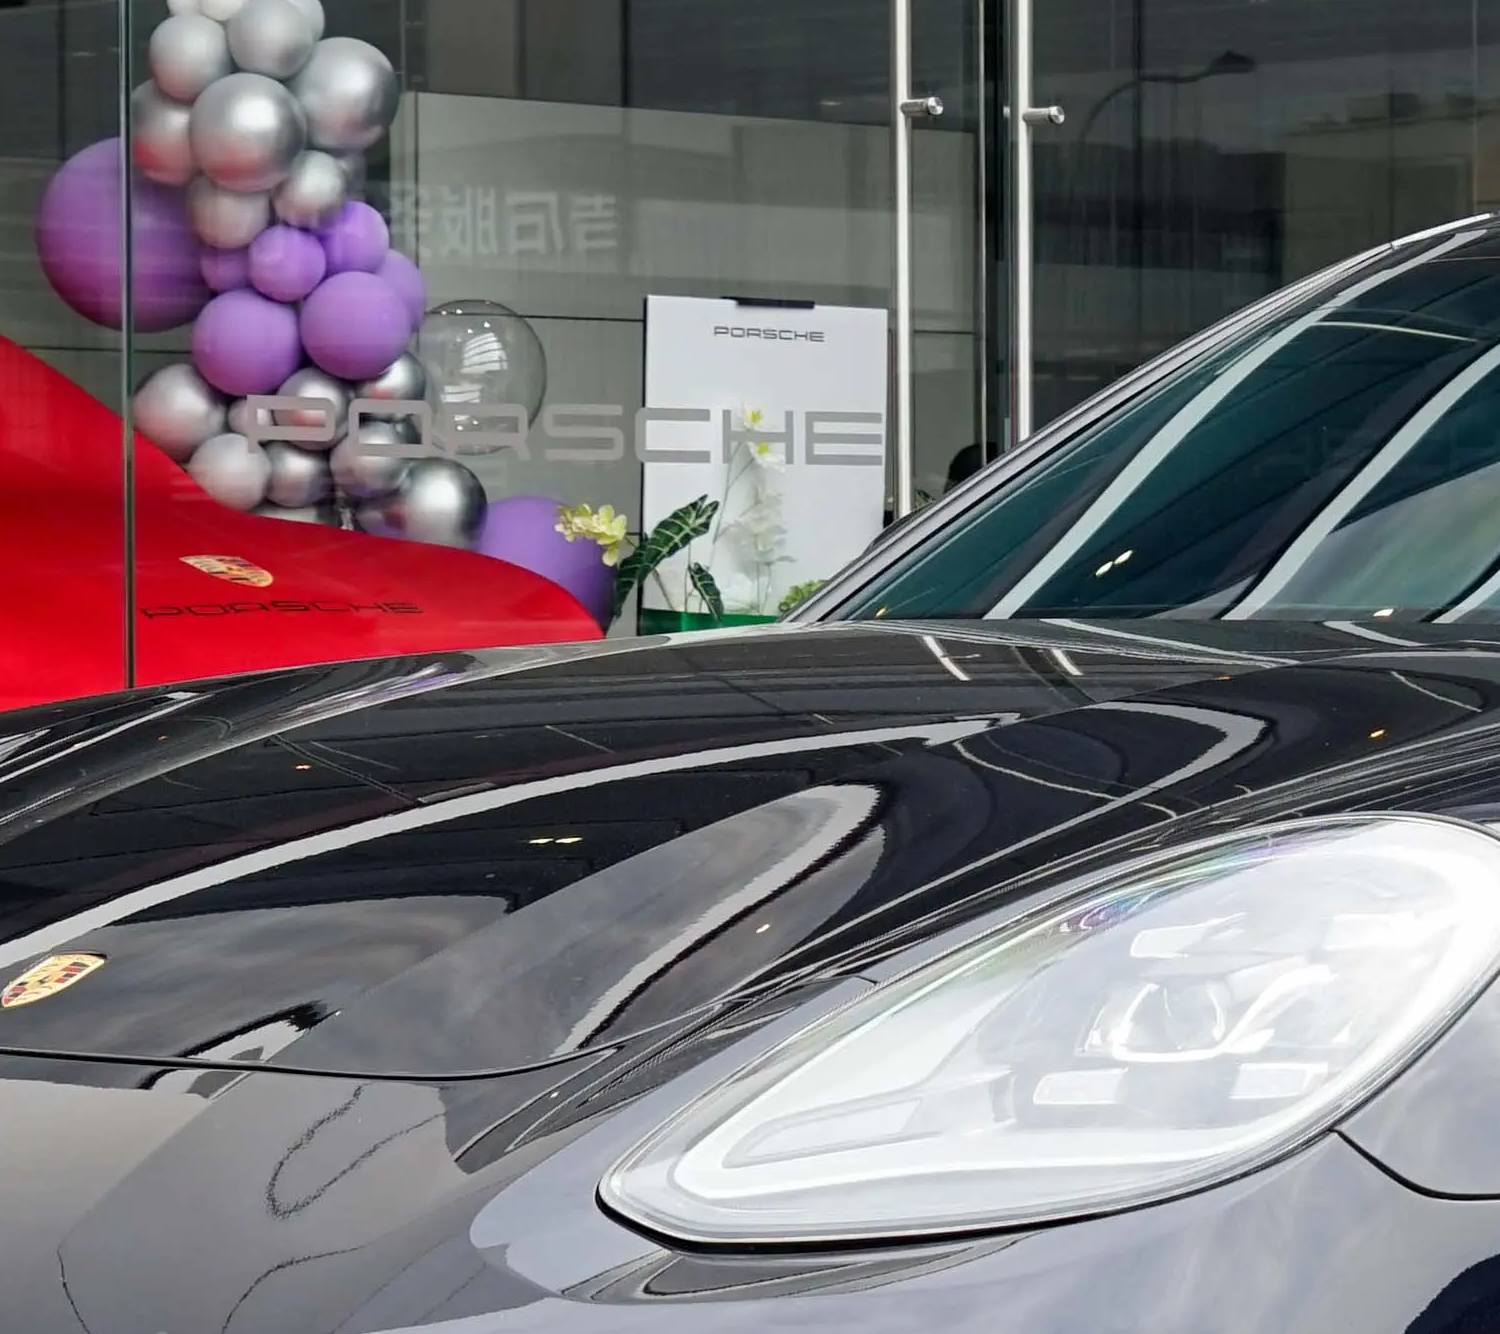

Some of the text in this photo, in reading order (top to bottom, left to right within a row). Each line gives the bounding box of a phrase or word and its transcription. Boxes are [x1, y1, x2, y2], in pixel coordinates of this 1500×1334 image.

[713, 325, 825, 343] PORSCHE
[246, 395, 883, 466] PORSCHE
[141, 599, 424, 619] PORSCHE
